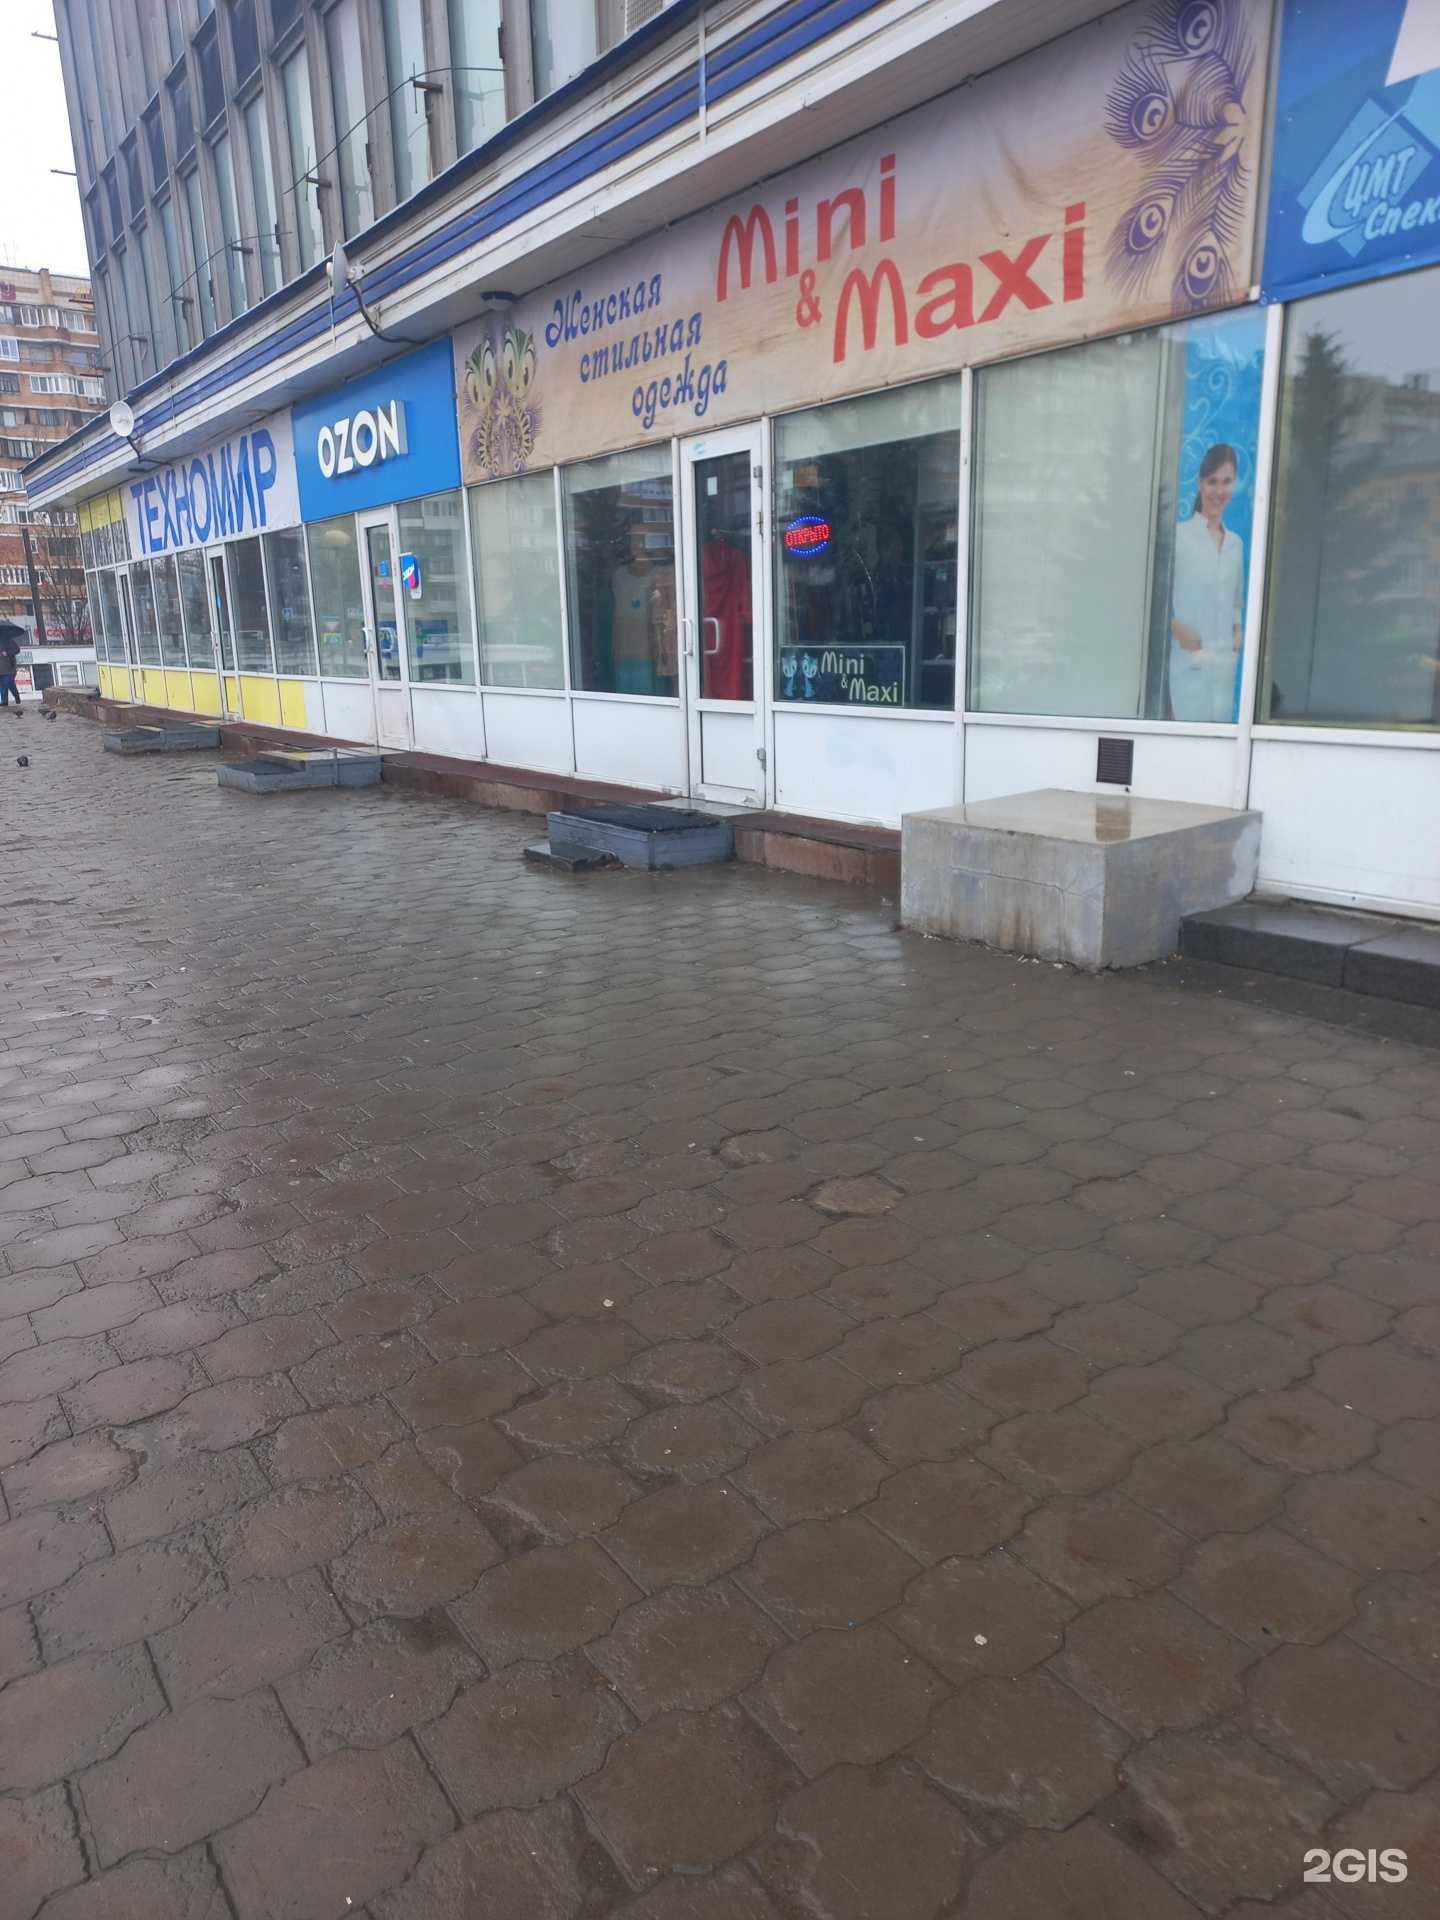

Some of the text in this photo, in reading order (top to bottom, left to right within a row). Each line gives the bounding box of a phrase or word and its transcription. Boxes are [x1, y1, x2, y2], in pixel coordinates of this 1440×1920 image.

[1343, 146, 1416, 217] ЦМТ
[1364, 194, 1440, 240] Спек
[716, 152, 896, 303] Mini
[545, 273, 662, 348] Женская
[796, 202, 1086, 364] & Maxi
[580, 312, 702, 383] стильная
[632, 352, 727, 430] одежда
[317, 400, 402, 478] OZON
[130, 428, 277, 555] ТЕХНОМИР
[785, 523, 830, 547] ОТКРЫТО
[820, 651, 865, 676] Mini
[840, 673, 899, 703] & Maxi
